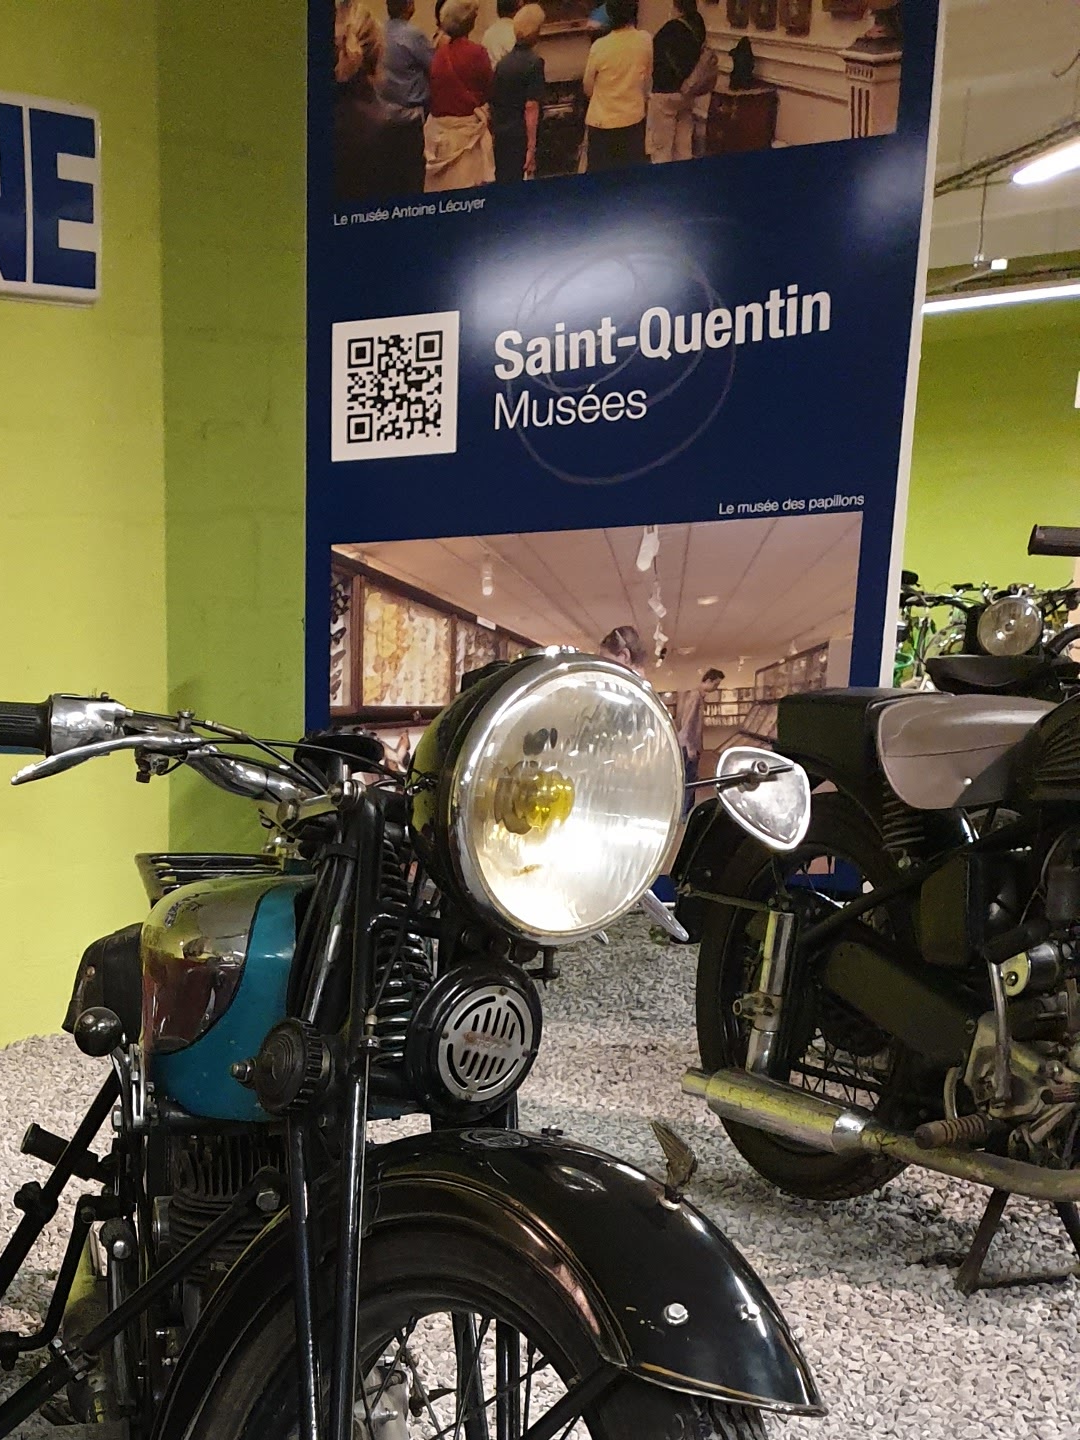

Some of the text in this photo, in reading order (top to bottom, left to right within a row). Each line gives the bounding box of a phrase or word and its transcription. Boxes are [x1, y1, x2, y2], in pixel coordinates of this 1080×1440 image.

[333, 198, 486, 226] Le musée Antoine Lécuyer
[494, 284, 832, 381] Saint-Quentin
[494, 384, 648, 430] Musées
[719, 494, 865, 515] Le musée des papillons
